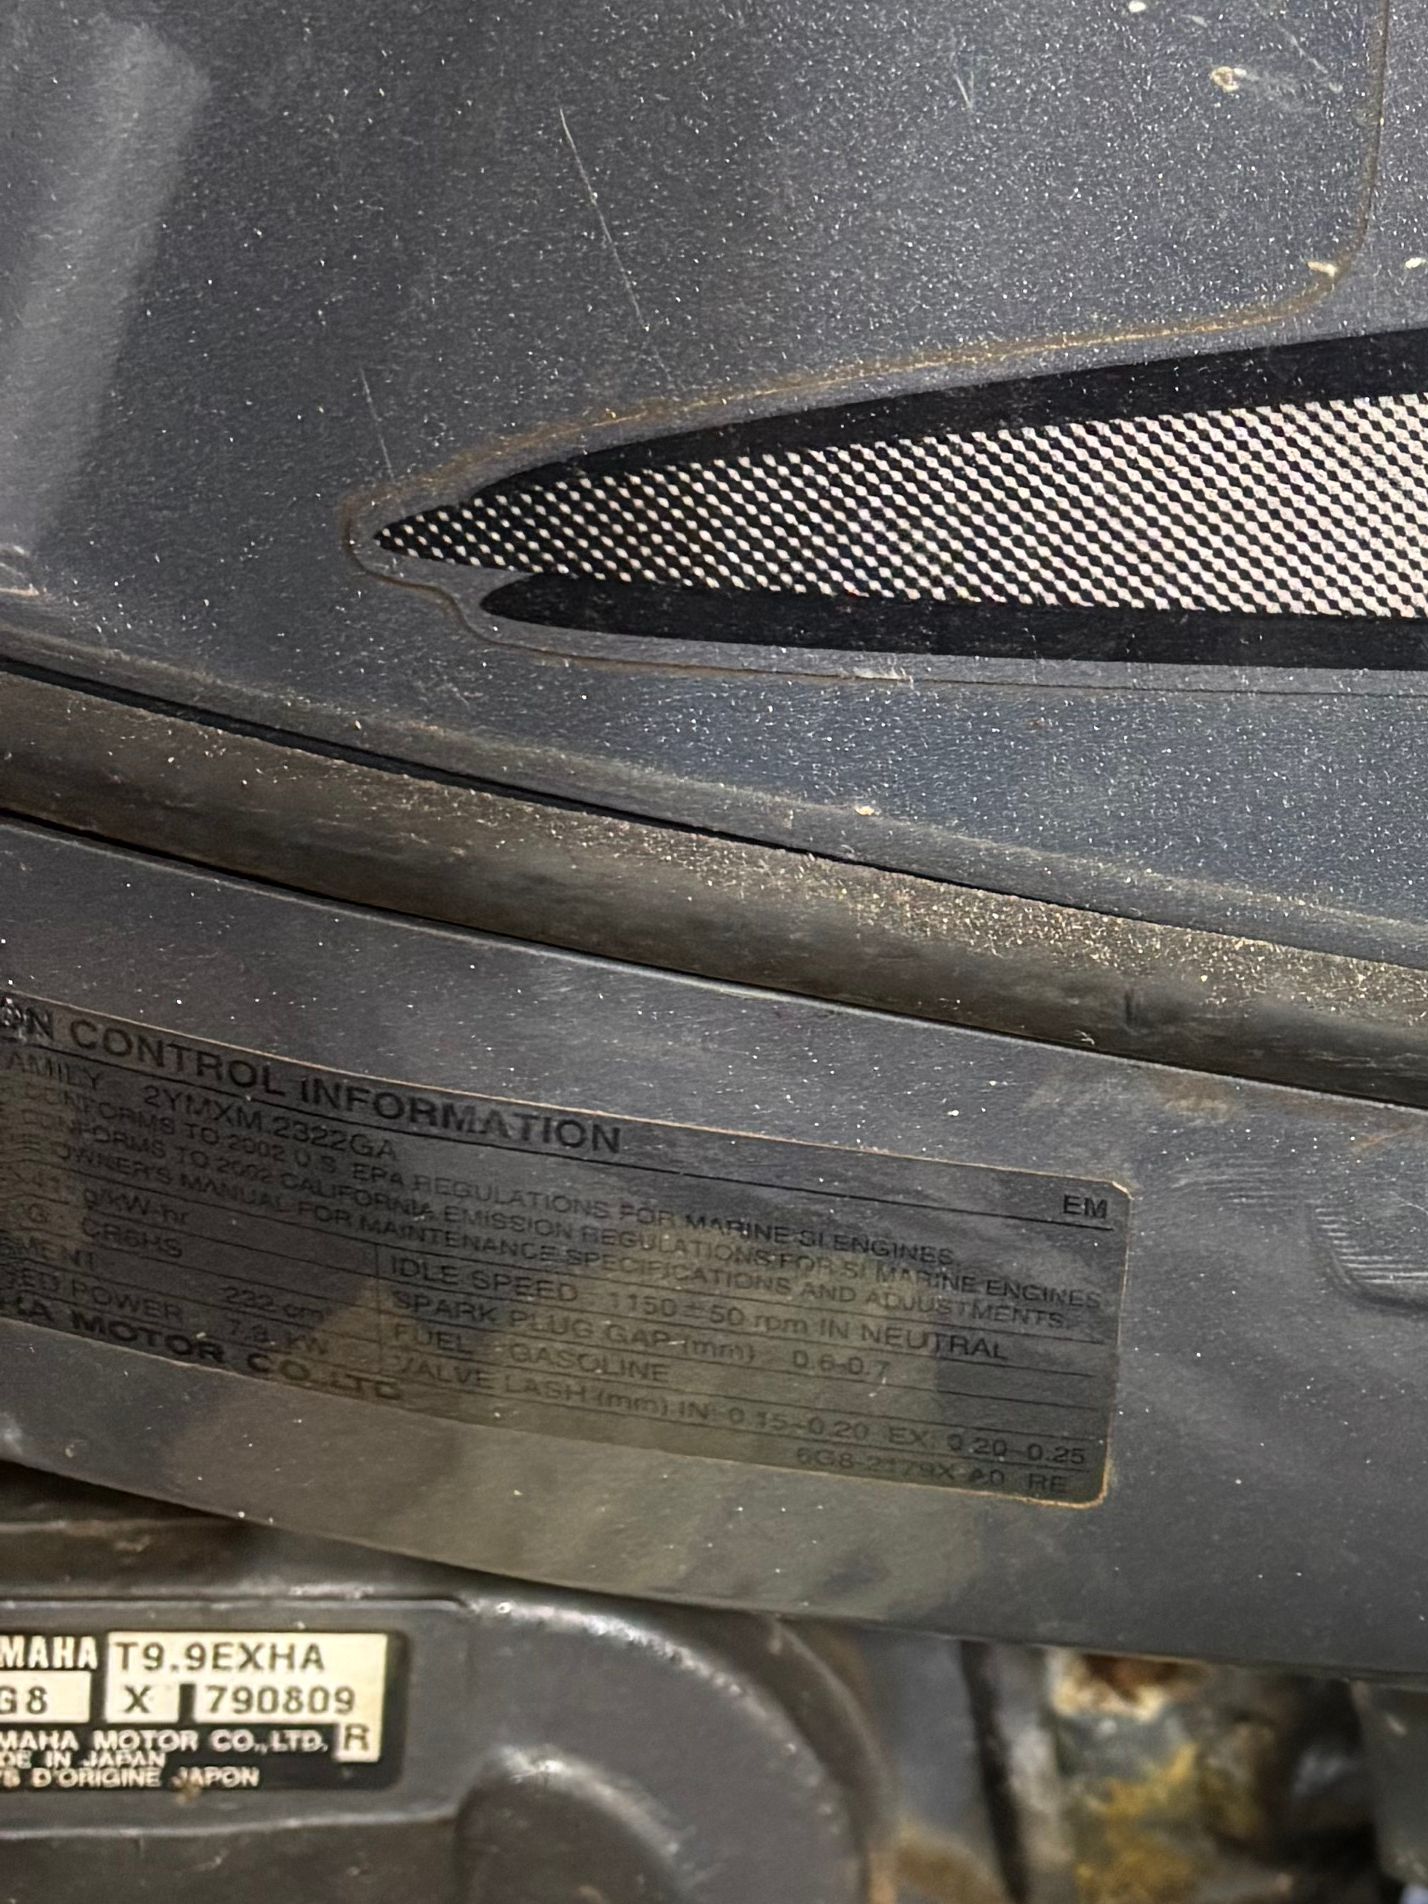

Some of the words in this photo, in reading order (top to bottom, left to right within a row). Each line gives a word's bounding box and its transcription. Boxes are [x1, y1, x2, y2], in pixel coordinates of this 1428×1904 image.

[70, 1019, 287, 1097] CONTROL
[301, 1077, 621, 1155] INFORMATION
[413, 1173, 610, 1219] REGULATIONS
[620, 1203, 676, 1227] FOR
[685, 1213, 797, 1245] MARINE
[1062, 1194, 1108, 1219] EM
[298, 1201, 351, 1224] FOR
[359, 1215, 557, 1264] MAINTENANCE
[565, 1247, 792, 1295] SPECIFICATIONS
[800, 1282, 857, 1305] AND
[444, 1205, 572, 1239] EMISSION
[581, 1226, 779, 1267] REGULATIONS
[875, 1263, 977, 1294] MARINE
[71, 1277, 183, 1324] POWER
[391, 1255, 459, 1286] IDLE
[471, 1268, 579, 1303] SPEED
[754, 1314, 809, 1337] rpm
[819, 1319, 850, 1341] IN
[860, 1323, 1009, 1361] NEUTRAL
[393, 1290, 498, 1326] SPARK
[510, 1307, 595, 1338] PLUG
[605, 1322, 669, 1348] GAP
[70, 1309, 225, 1365] MOTOR
[398, 1354, 498, 1389] VALVE
[504, 1372, 587, 1404] LASH
[508, 1340, 671, 1383] GASOLINE
[114, 1641, 326, 1674] T9.9EXHA
[124, 1685, 152, 1715] X
[205, 1684, 356, 1715] 790809
[45, 1750, 73, 1769] IN
[80, 1750, 166, 1769] JAPAN
[93, 1729, 199, 1751] MOTOR
[343, 1724, 370, 1752] R
[31, 1767, 163, 1789] D'ORIGINE
[171, 1766, 260, 1790] JAPON
